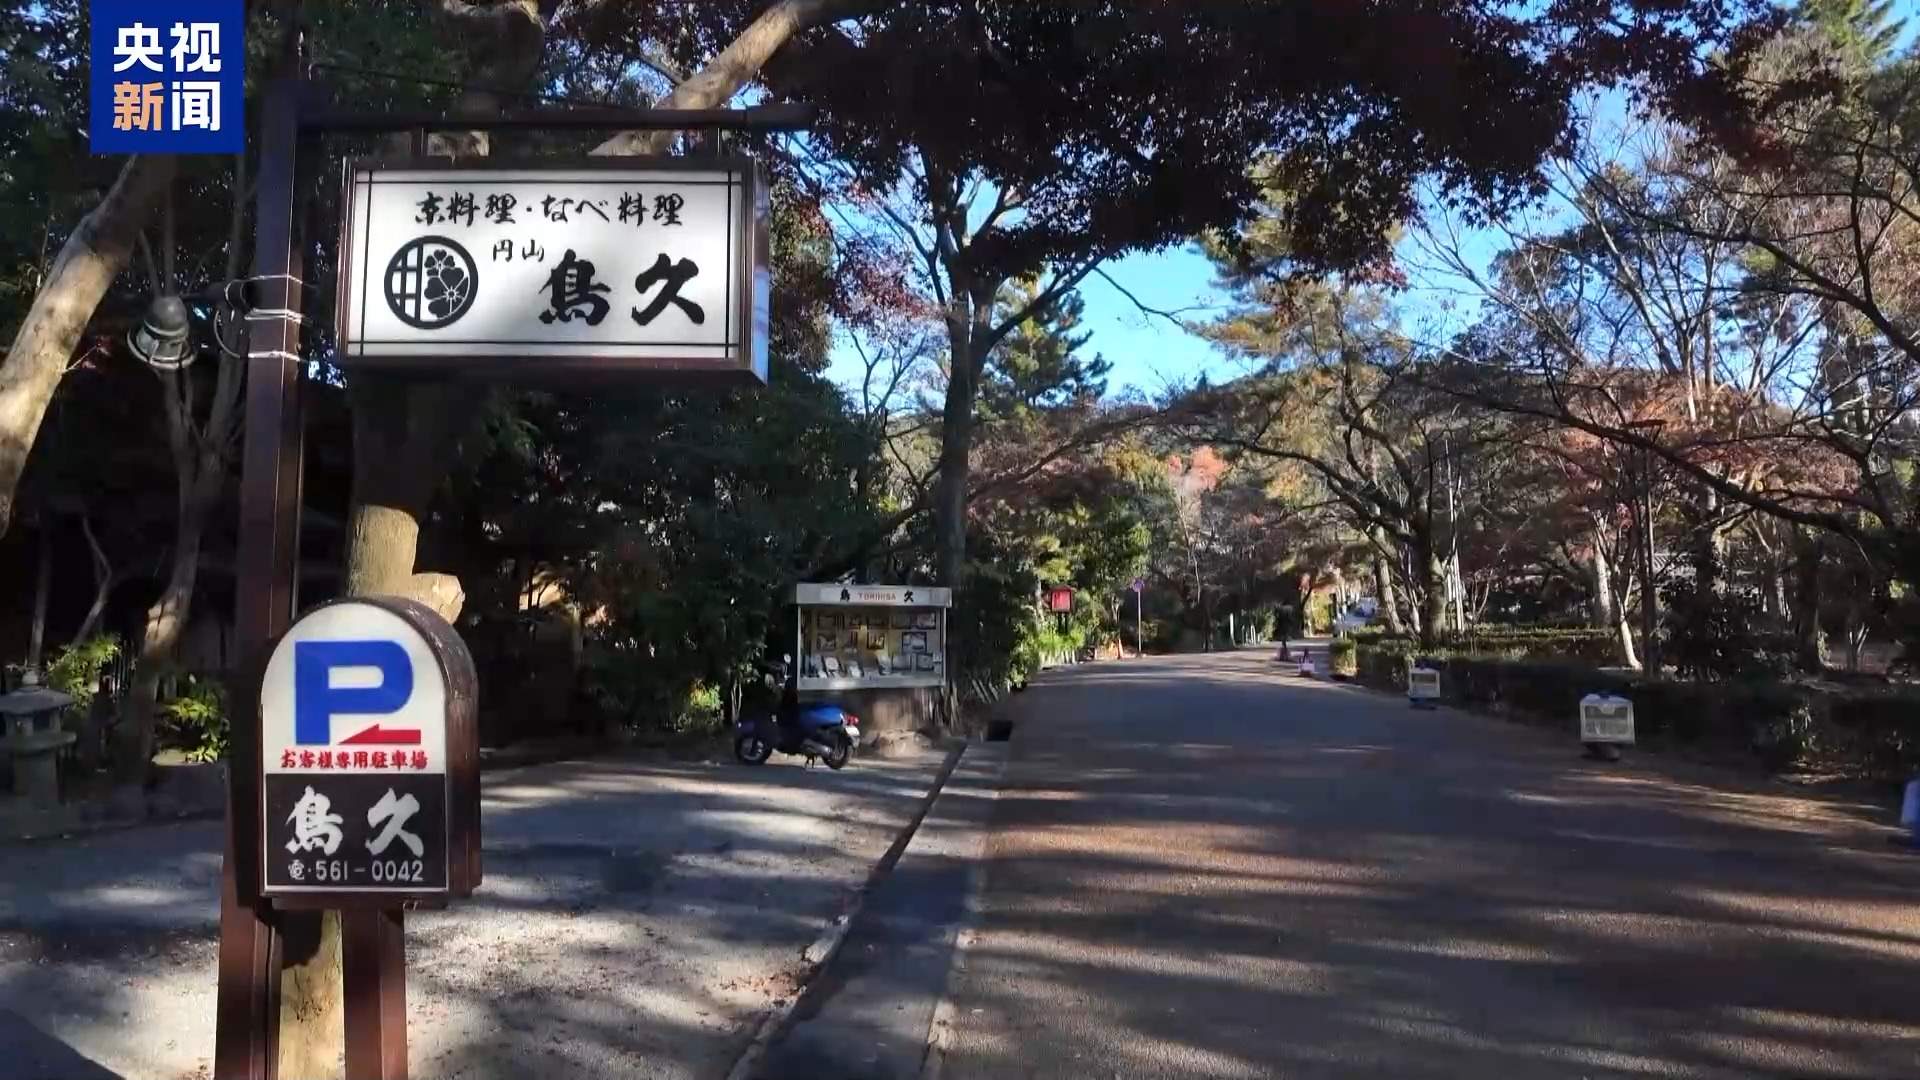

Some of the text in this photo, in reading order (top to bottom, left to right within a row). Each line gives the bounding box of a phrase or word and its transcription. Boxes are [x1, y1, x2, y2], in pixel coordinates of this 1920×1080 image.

[492, 238, 545, 263] 円山
[538, 248, 706, 327] 鳥久
[295, 640, 414, 745] P
[284, 784, 425, 857] 鳥久
